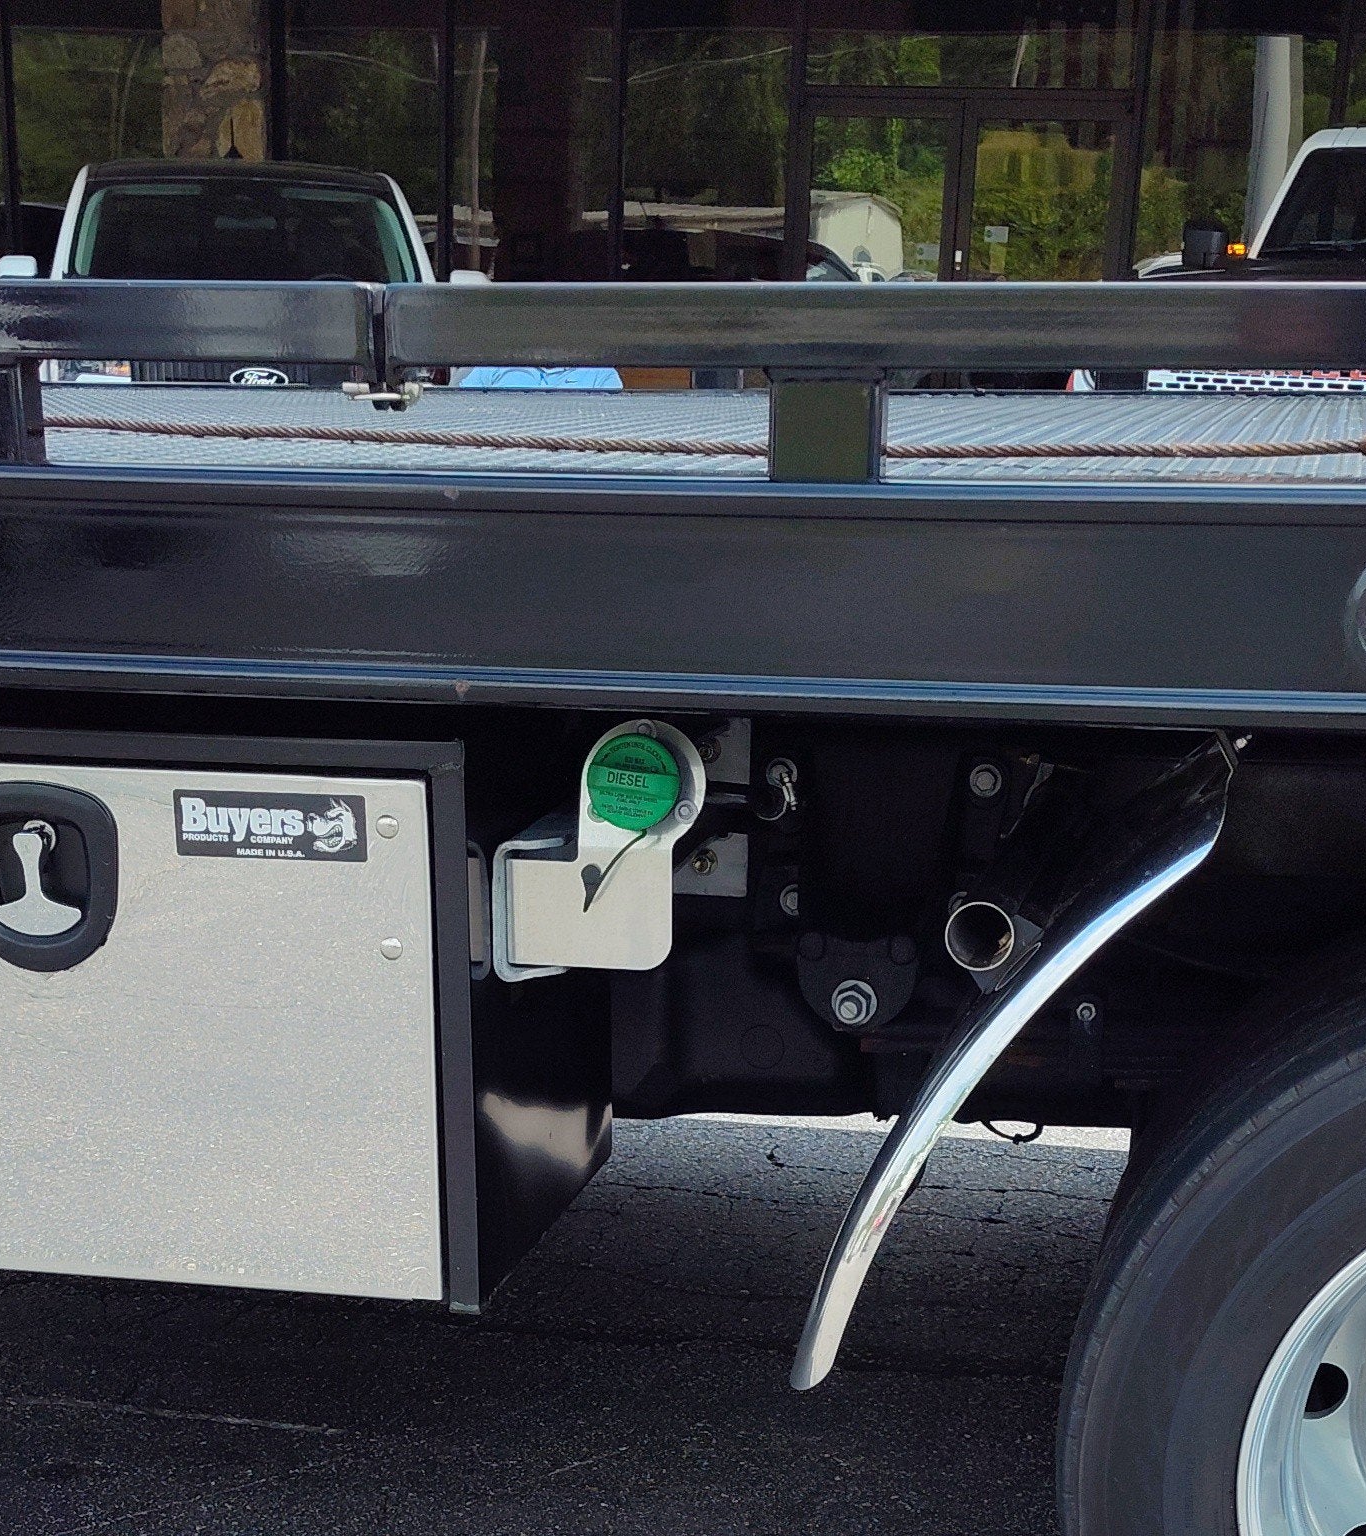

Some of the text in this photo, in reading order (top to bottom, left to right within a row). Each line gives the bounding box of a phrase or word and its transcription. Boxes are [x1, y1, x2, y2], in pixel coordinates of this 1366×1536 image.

[606, 770, 650, 789] DIESEL
[179, 796, 305, 843] Buyers
[182, 833, 295, 845] PRODUCTS COMPANY
[236, 848, 306, 858] MADE IN U.S.A.
